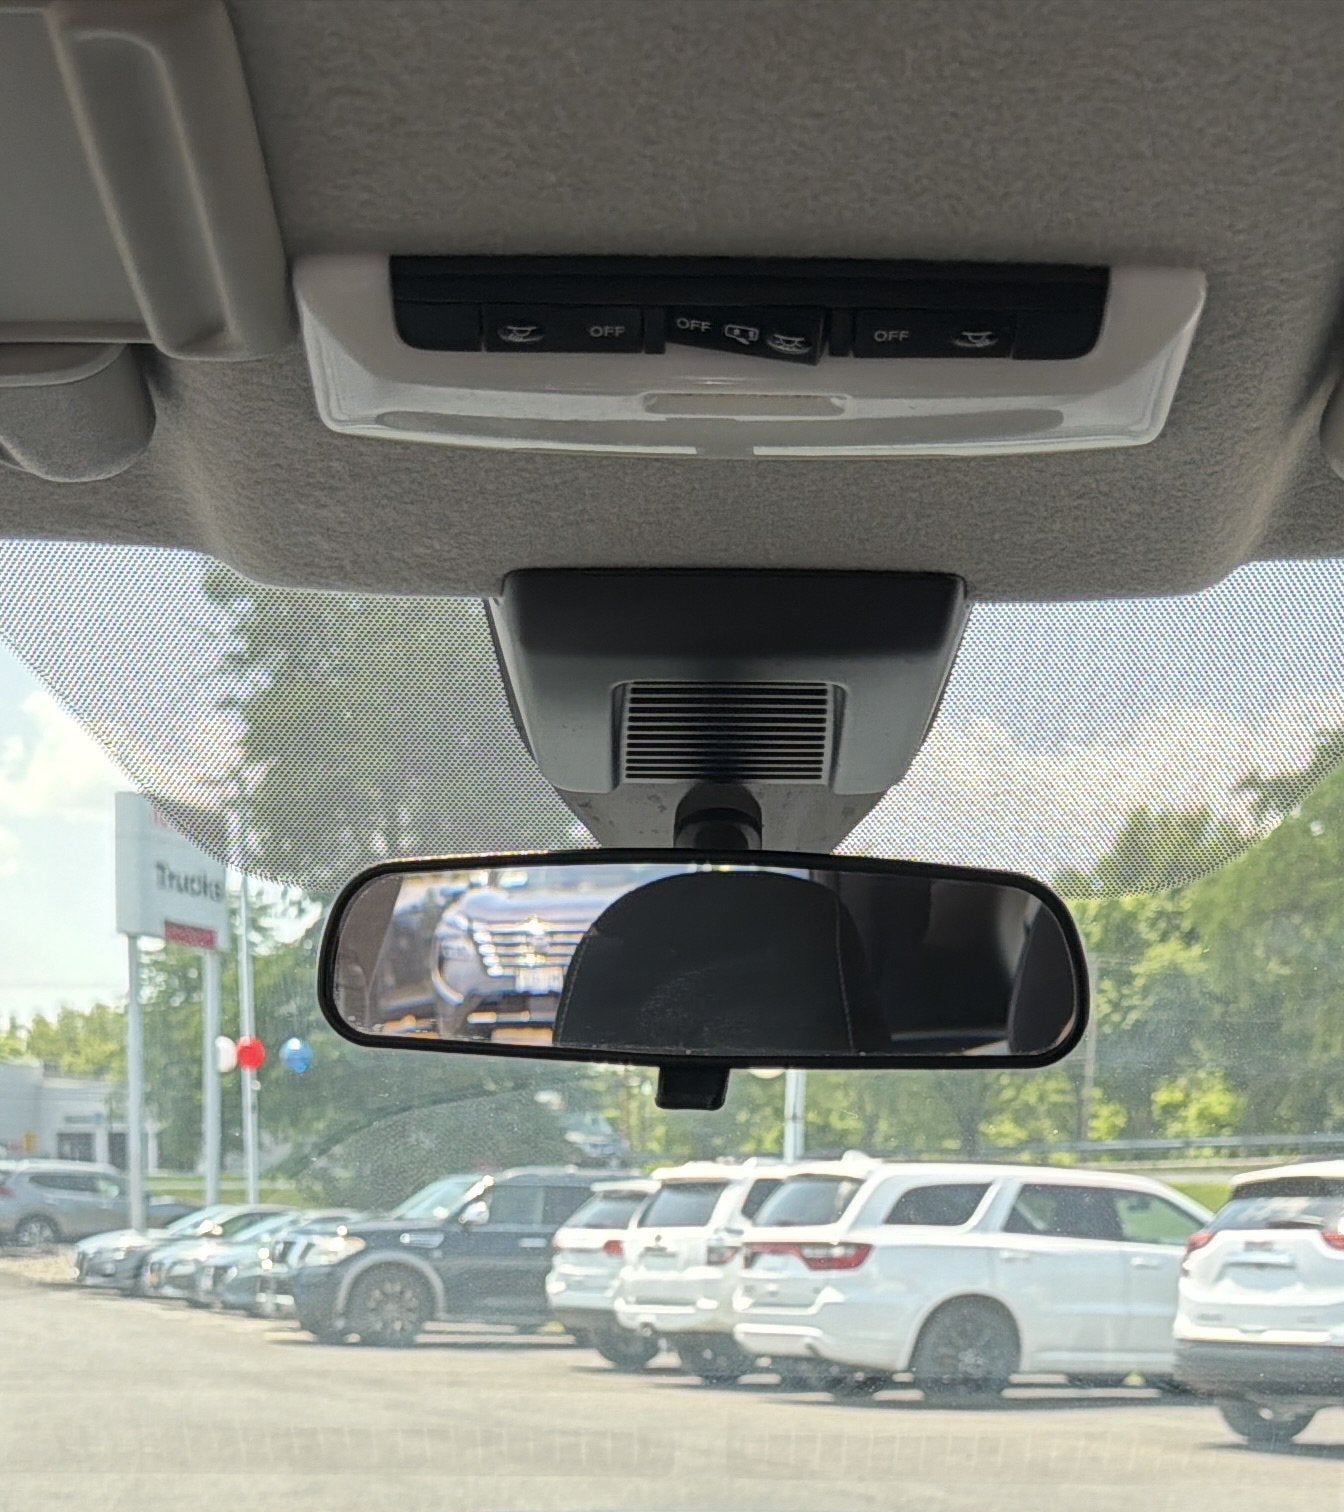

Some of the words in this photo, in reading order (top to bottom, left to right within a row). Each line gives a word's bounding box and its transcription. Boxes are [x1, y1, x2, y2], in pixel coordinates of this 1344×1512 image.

[589, 325, 625, 340] OFF
[676, 318, 711, 334] OFF
[874, 328, 910, 344] OFF
